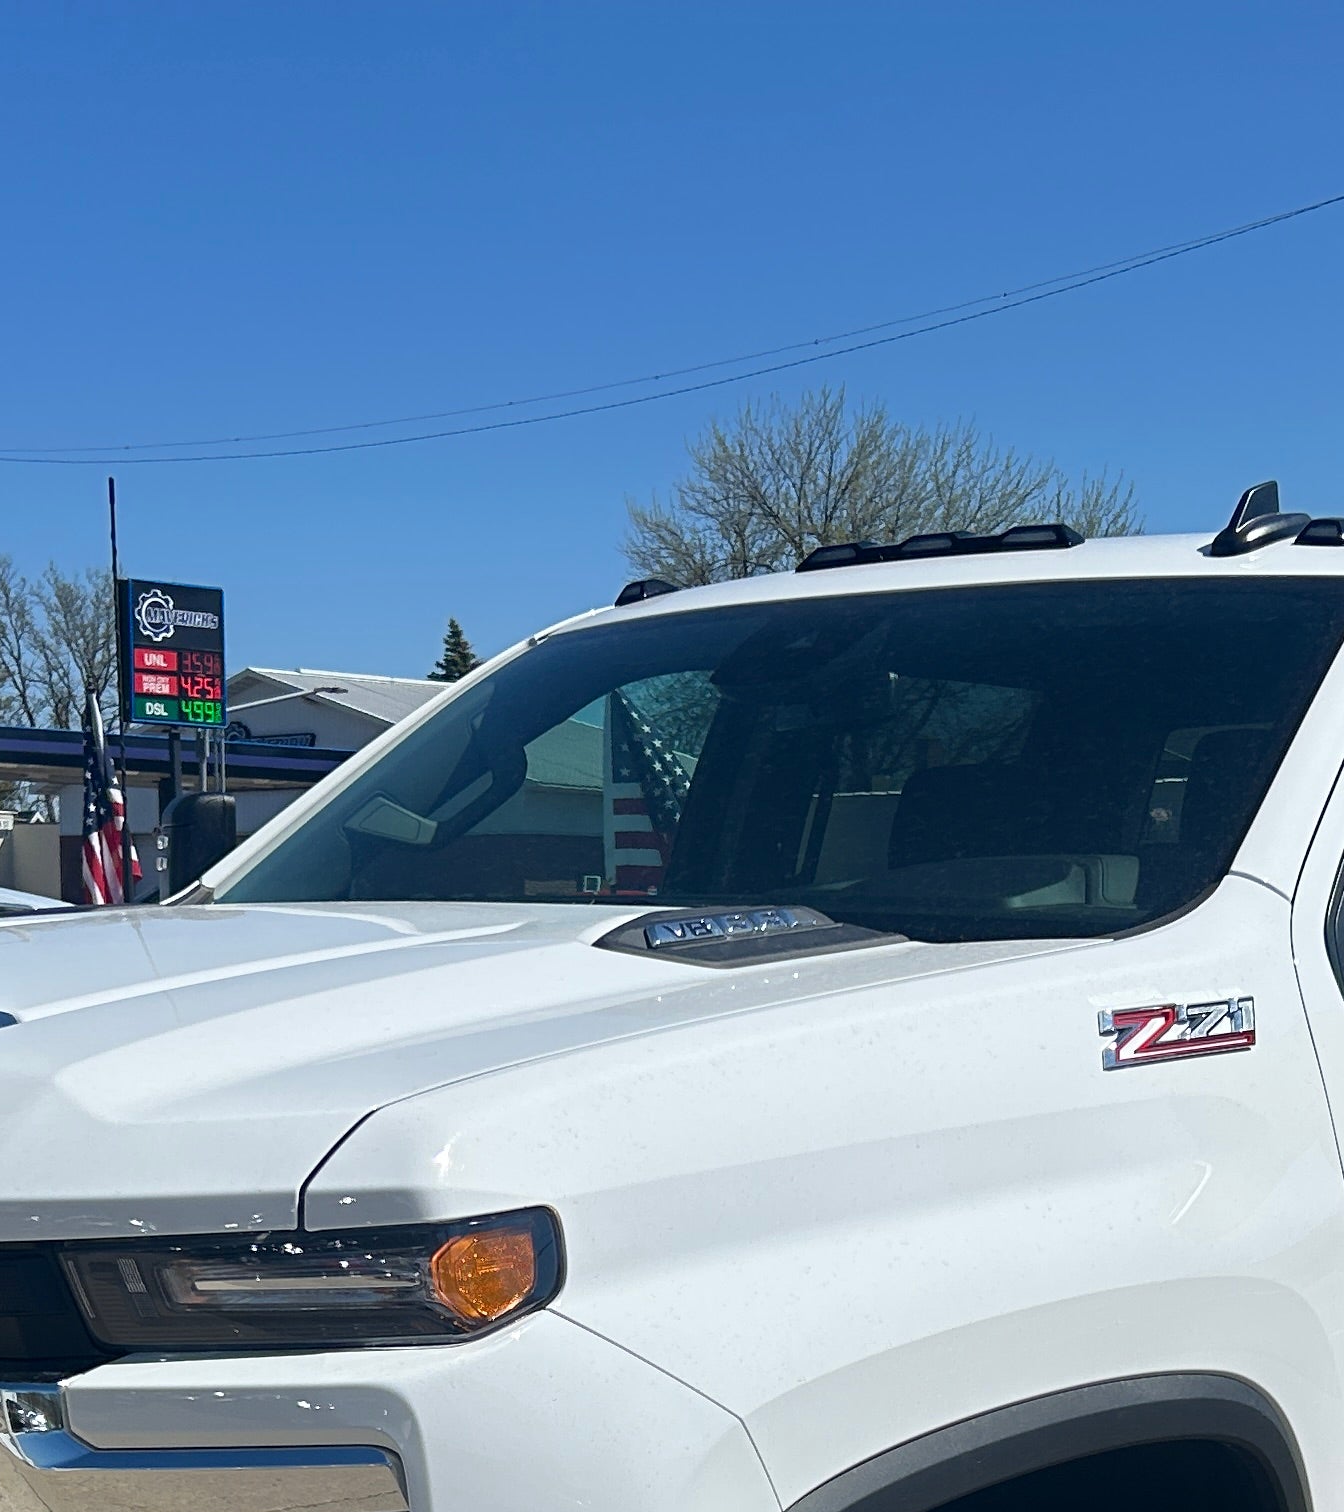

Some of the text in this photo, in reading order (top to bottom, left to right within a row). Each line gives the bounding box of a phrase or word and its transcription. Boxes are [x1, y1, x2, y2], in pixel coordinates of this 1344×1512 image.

[144, 652, 168, 667] UNL
[143, 683, 170, 694] PREM
[146, 702, 168, 716] DSL
[1097, 996, 1256, 1071] Z71
